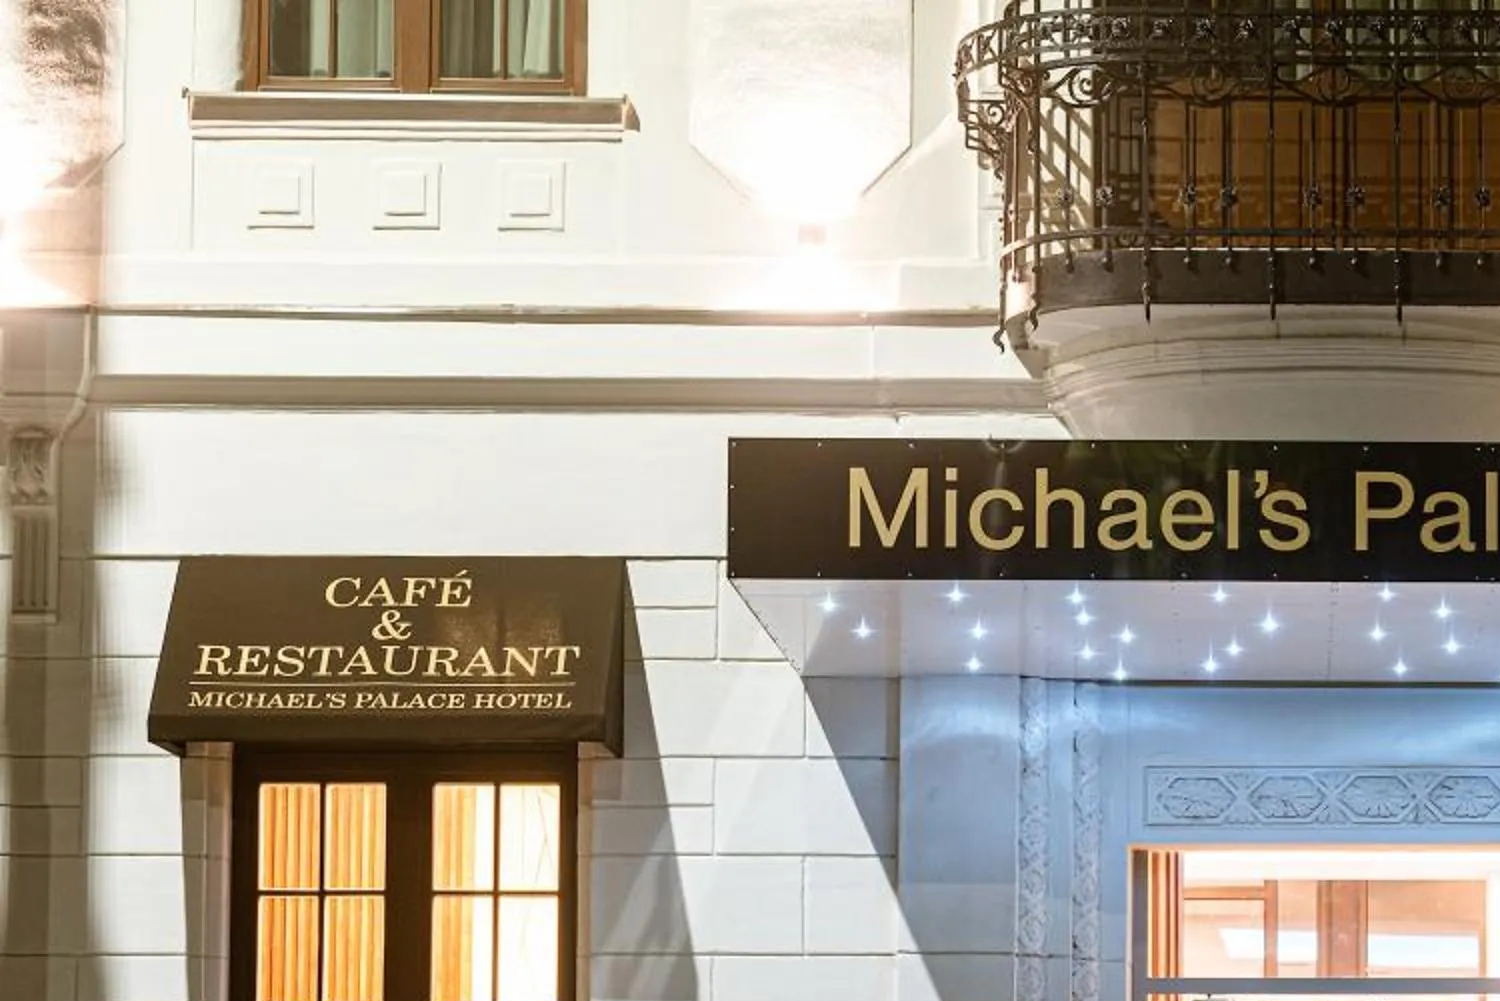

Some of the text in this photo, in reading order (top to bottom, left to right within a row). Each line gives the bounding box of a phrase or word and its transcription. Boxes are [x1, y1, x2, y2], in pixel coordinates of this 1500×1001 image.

[845, 466, 1310, 554] Michael's
[324, 569, 474, 608] CAFÉ
[371, 608, 412, 641] &
[193, 643, 582, 678] RESTAURANT
[187, 690, 573, 710] MICHAEL'S PALACE HOTEL
